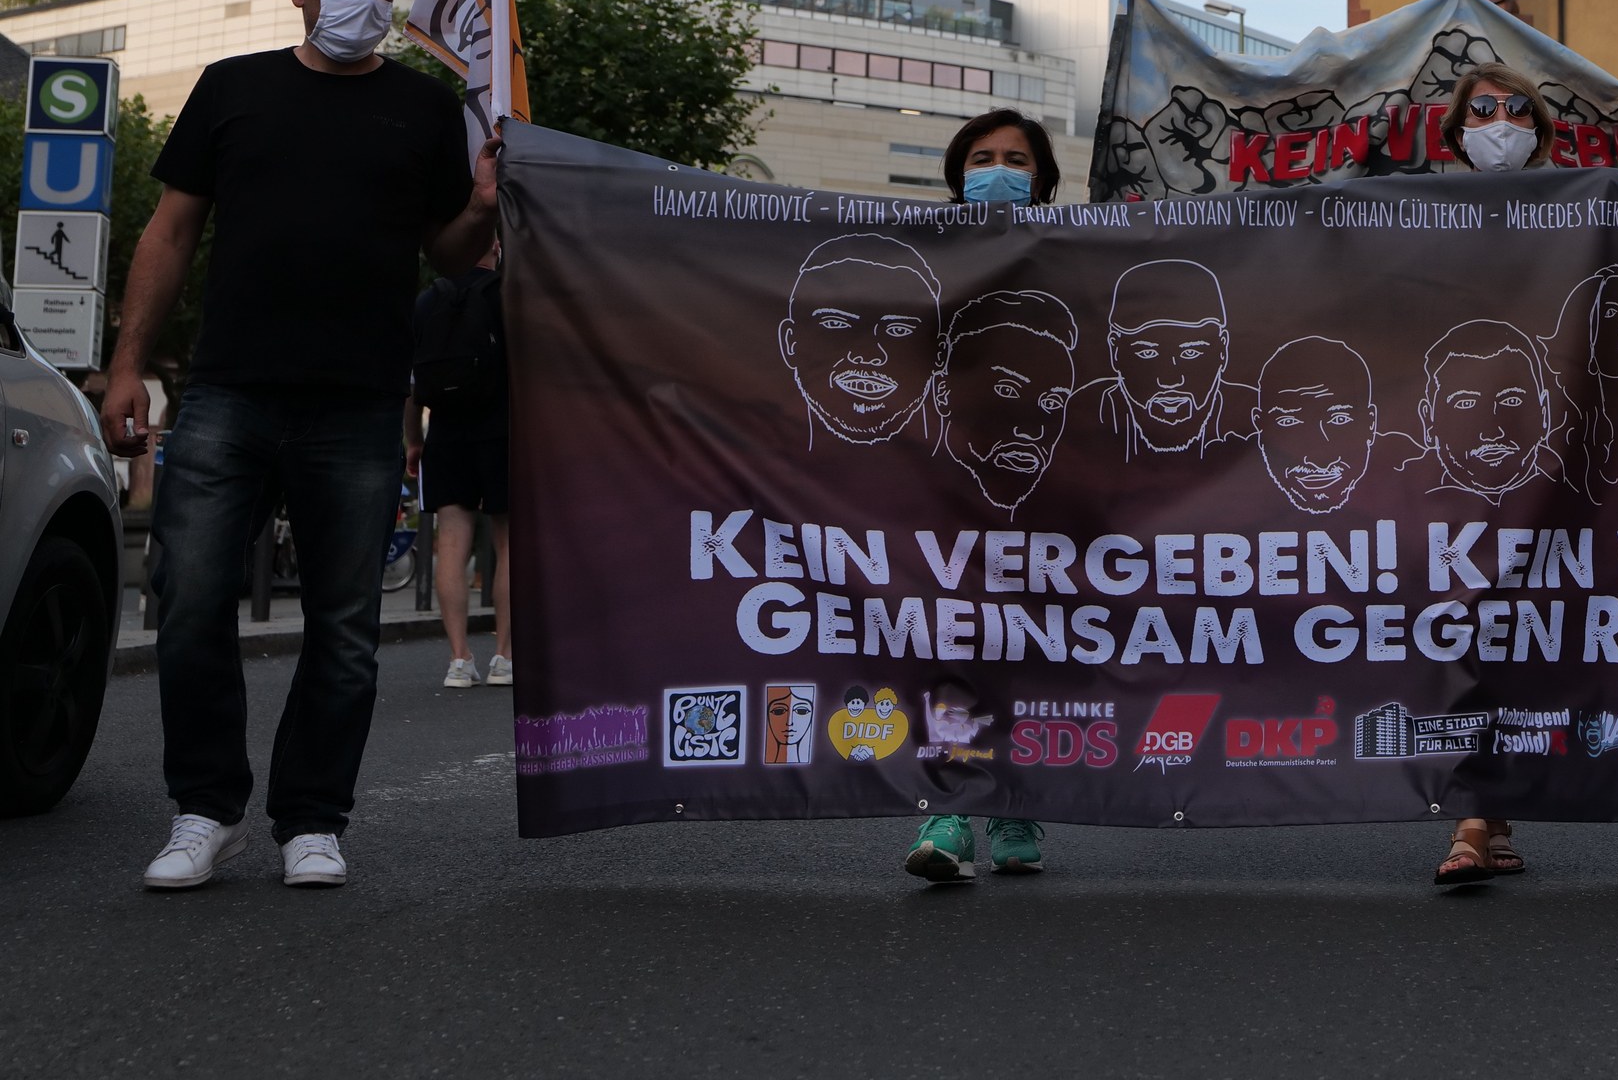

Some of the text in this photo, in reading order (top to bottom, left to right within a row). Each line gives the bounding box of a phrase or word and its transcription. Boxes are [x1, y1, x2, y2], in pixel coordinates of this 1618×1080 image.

[49, 74, 88, 118] S
[1229, 116, 1370, 182] KEIN
[29, 141, 99, 204] U
[653, 185, 718, 218] HAMZA
[724, 188, 815, 223] KURTOVIĆ
[837, 196, 885, 224] FATIH
[1070, 203, 1131, 227] UNVAR
[1154, 199, 1231, 227] KALOYAN
[1236, 196, 1297, 228] VELKOV
[1321, 196, 1393, 228] GÖKHAN
[1399, 199, 1483, 229] GÜLTEKIN
[1506, 200, 1582, 229] MERCEDES
[690, 510, 890, 586] KEIN
[914, 519, 1399, 597] VERGEBEN!
[1427, 519, 1594, 594] KEIN
[736, 581, 1265, 667] GEMEINSAM
[1293, 599, 1565, 664] GEGEN
[673, 694, 737, 731] BUNTE
[843, 721, 895, 741] DIDF
[1417, 716, 1484, 733] EINE STADT
[1496, 707, 1570, 728] linksjugend
[1010, 720, 1119, 768] SDS
[1142, 731, 1193, 752] DGB
[1225, 719, 1339, 759] DKP
[1419, 737, 1476, 751] FÜR ALLE!
[1258, 759, 1315, 767] Kommunistische
[1316, 758, 1337, 766] Partei
